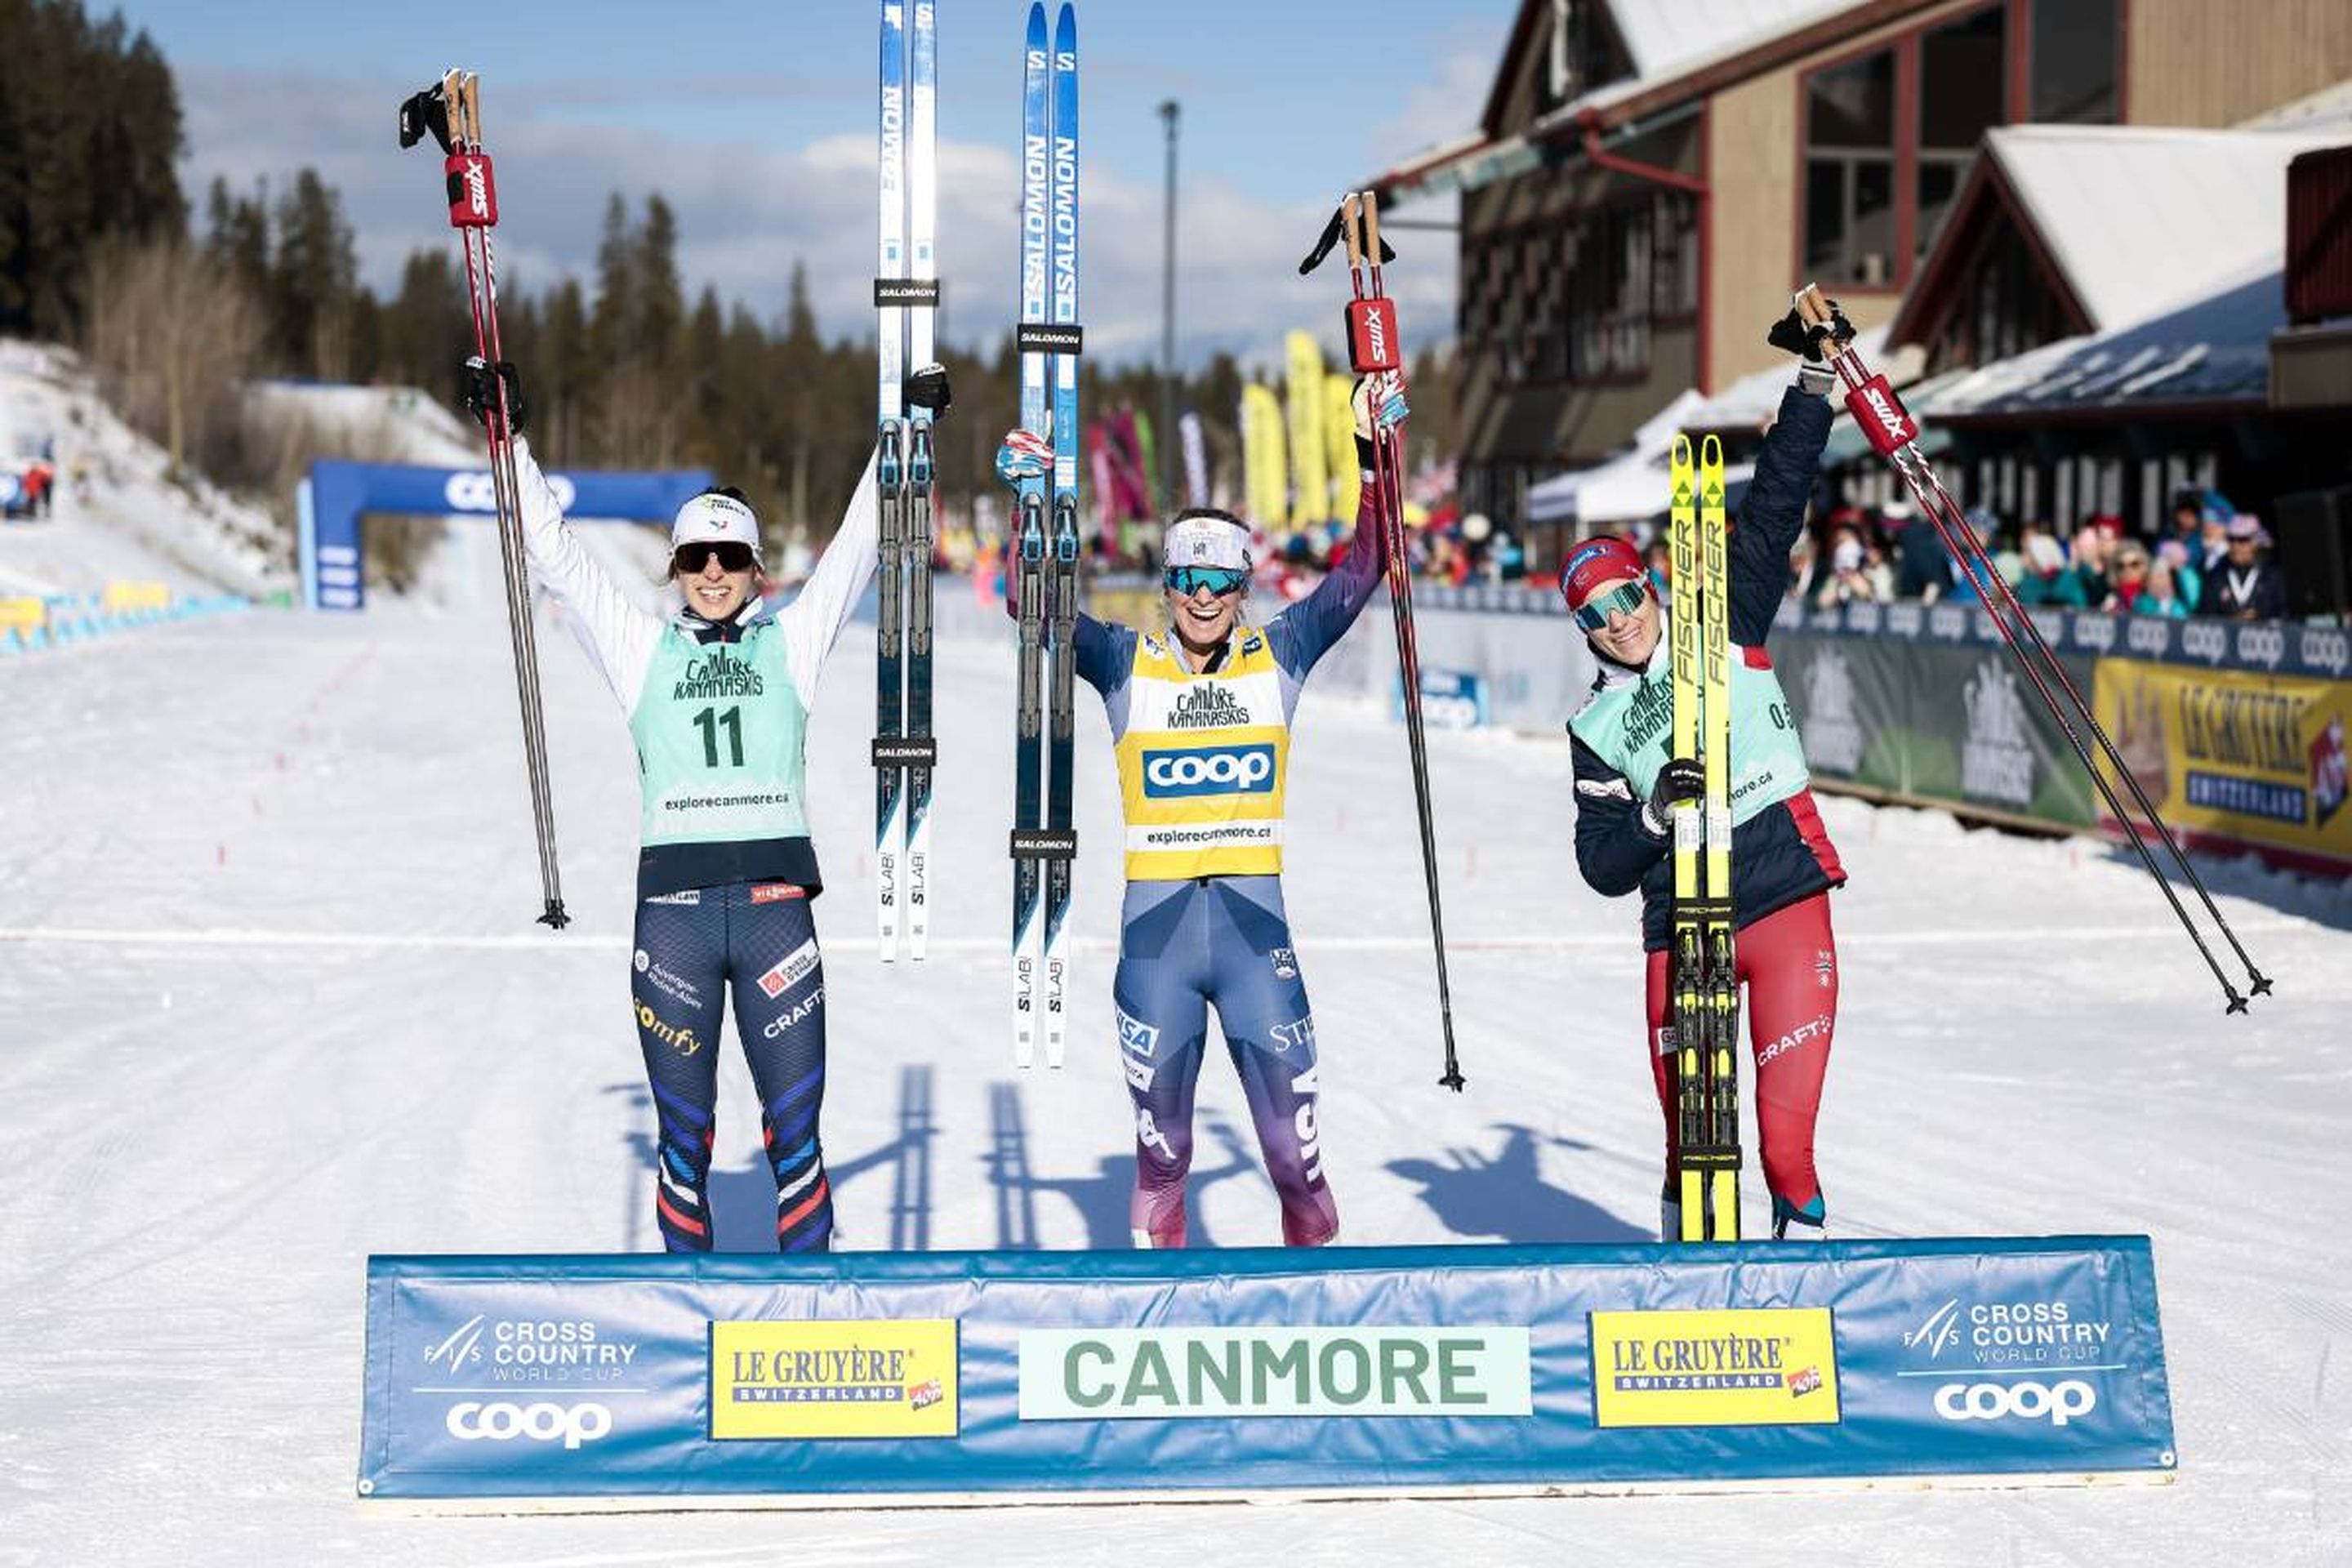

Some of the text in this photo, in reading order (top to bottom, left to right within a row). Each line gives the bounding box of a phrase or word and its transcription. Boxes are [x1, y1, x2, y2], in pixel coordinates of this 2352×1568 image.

[1057, 52, 1075, 71] S
[1027, 136, 1046, 299] SALOMON
[1056, 138, 1075, 300] SALOMON
[880, 288, 937, 297] SALOMON
[1021, 333, 1079, 344] SALOMON
[1677, 519, 1693, 686] FISCHER
[1706, 520, 1725, 686] FISCHER
[1177, 681, 1237, 711] CANMORE
[1168, 707, 1250, 728] KANANASKIS
[693, 705, 745, 768] 11
[876, 748, 932, 757] SALOMON
[1148, 752, 1271, 788] coop
[666, 793, 790, 810] explorecanmore.ca
[1014, 840, 1073, 849] SALOMON
[764, 988, 822, 1039] CRAFT
[1971, 1303, 2068, 1324] CROSS
[495, 1321, 595, 1343] CROSS
[1972, 1323, 2109, 1345] COUNTRY
[494, 1344, 636, 1365] COUNTRY
[1615, 1342, 1644, 1370] LE
[1974, 1346, 2100, 1363] WORLD CUP
[494, 1367, 623, 1381] WORLD CUP
[733, 1352, 768, 1383] LE
[1064, 1338, 1488, 1407] CANMORE
[1621, 1375, 1775, 1390] SWITZERLAND
[740, 1388, 898, 1401] SWITZERLAND
[1934, 1380, 2096, 1427] coop
[446, 1402, 611, 1449] coop
